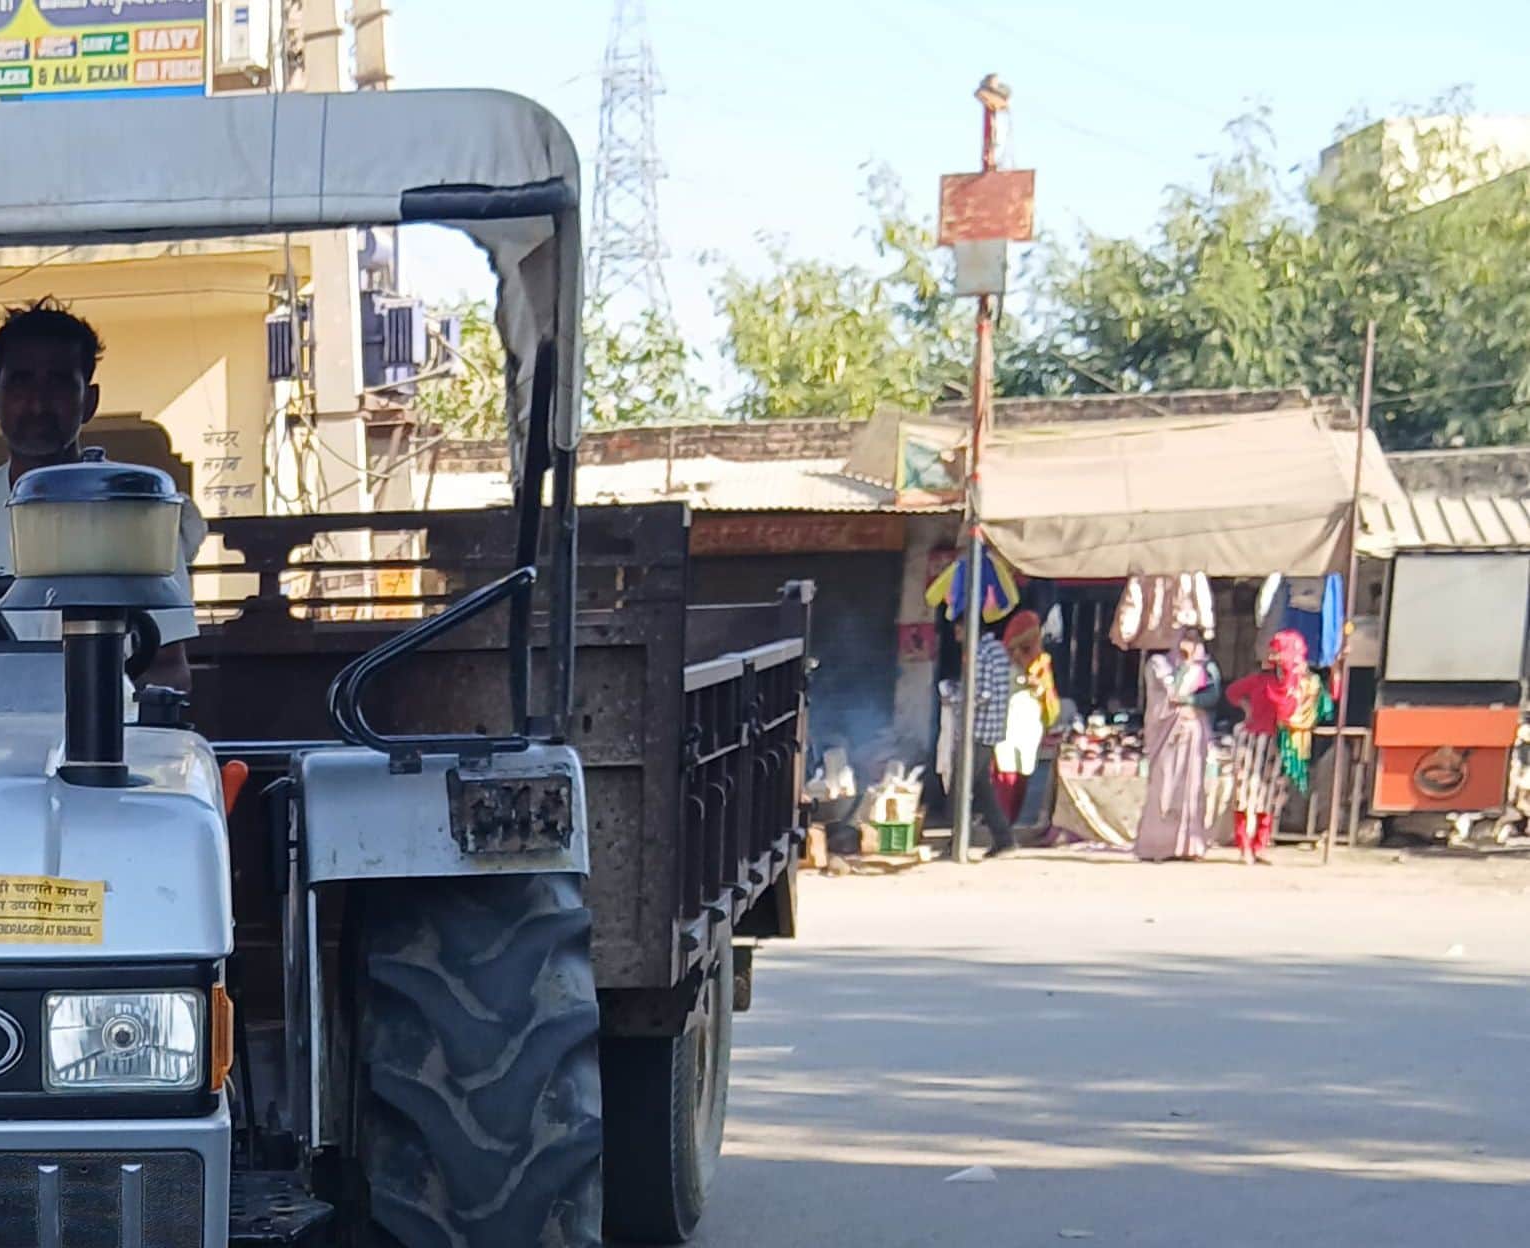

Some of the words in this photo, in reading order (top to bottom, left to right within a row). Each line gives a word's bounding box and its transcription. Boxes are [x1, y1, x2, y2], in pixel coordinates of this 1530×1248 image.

[139, 29, 199, 51] NAVY
[53, 64, 82, 85] ALL
[87, 64, 128, 83] EXAM
[12, 880, 53, 895] चलाते
[55, 885, 89, 898] समय
[7, 897, 54, 913] उपयोग
[55, 902, 71, 913] ना
[44, 924, 56, 936] AT
